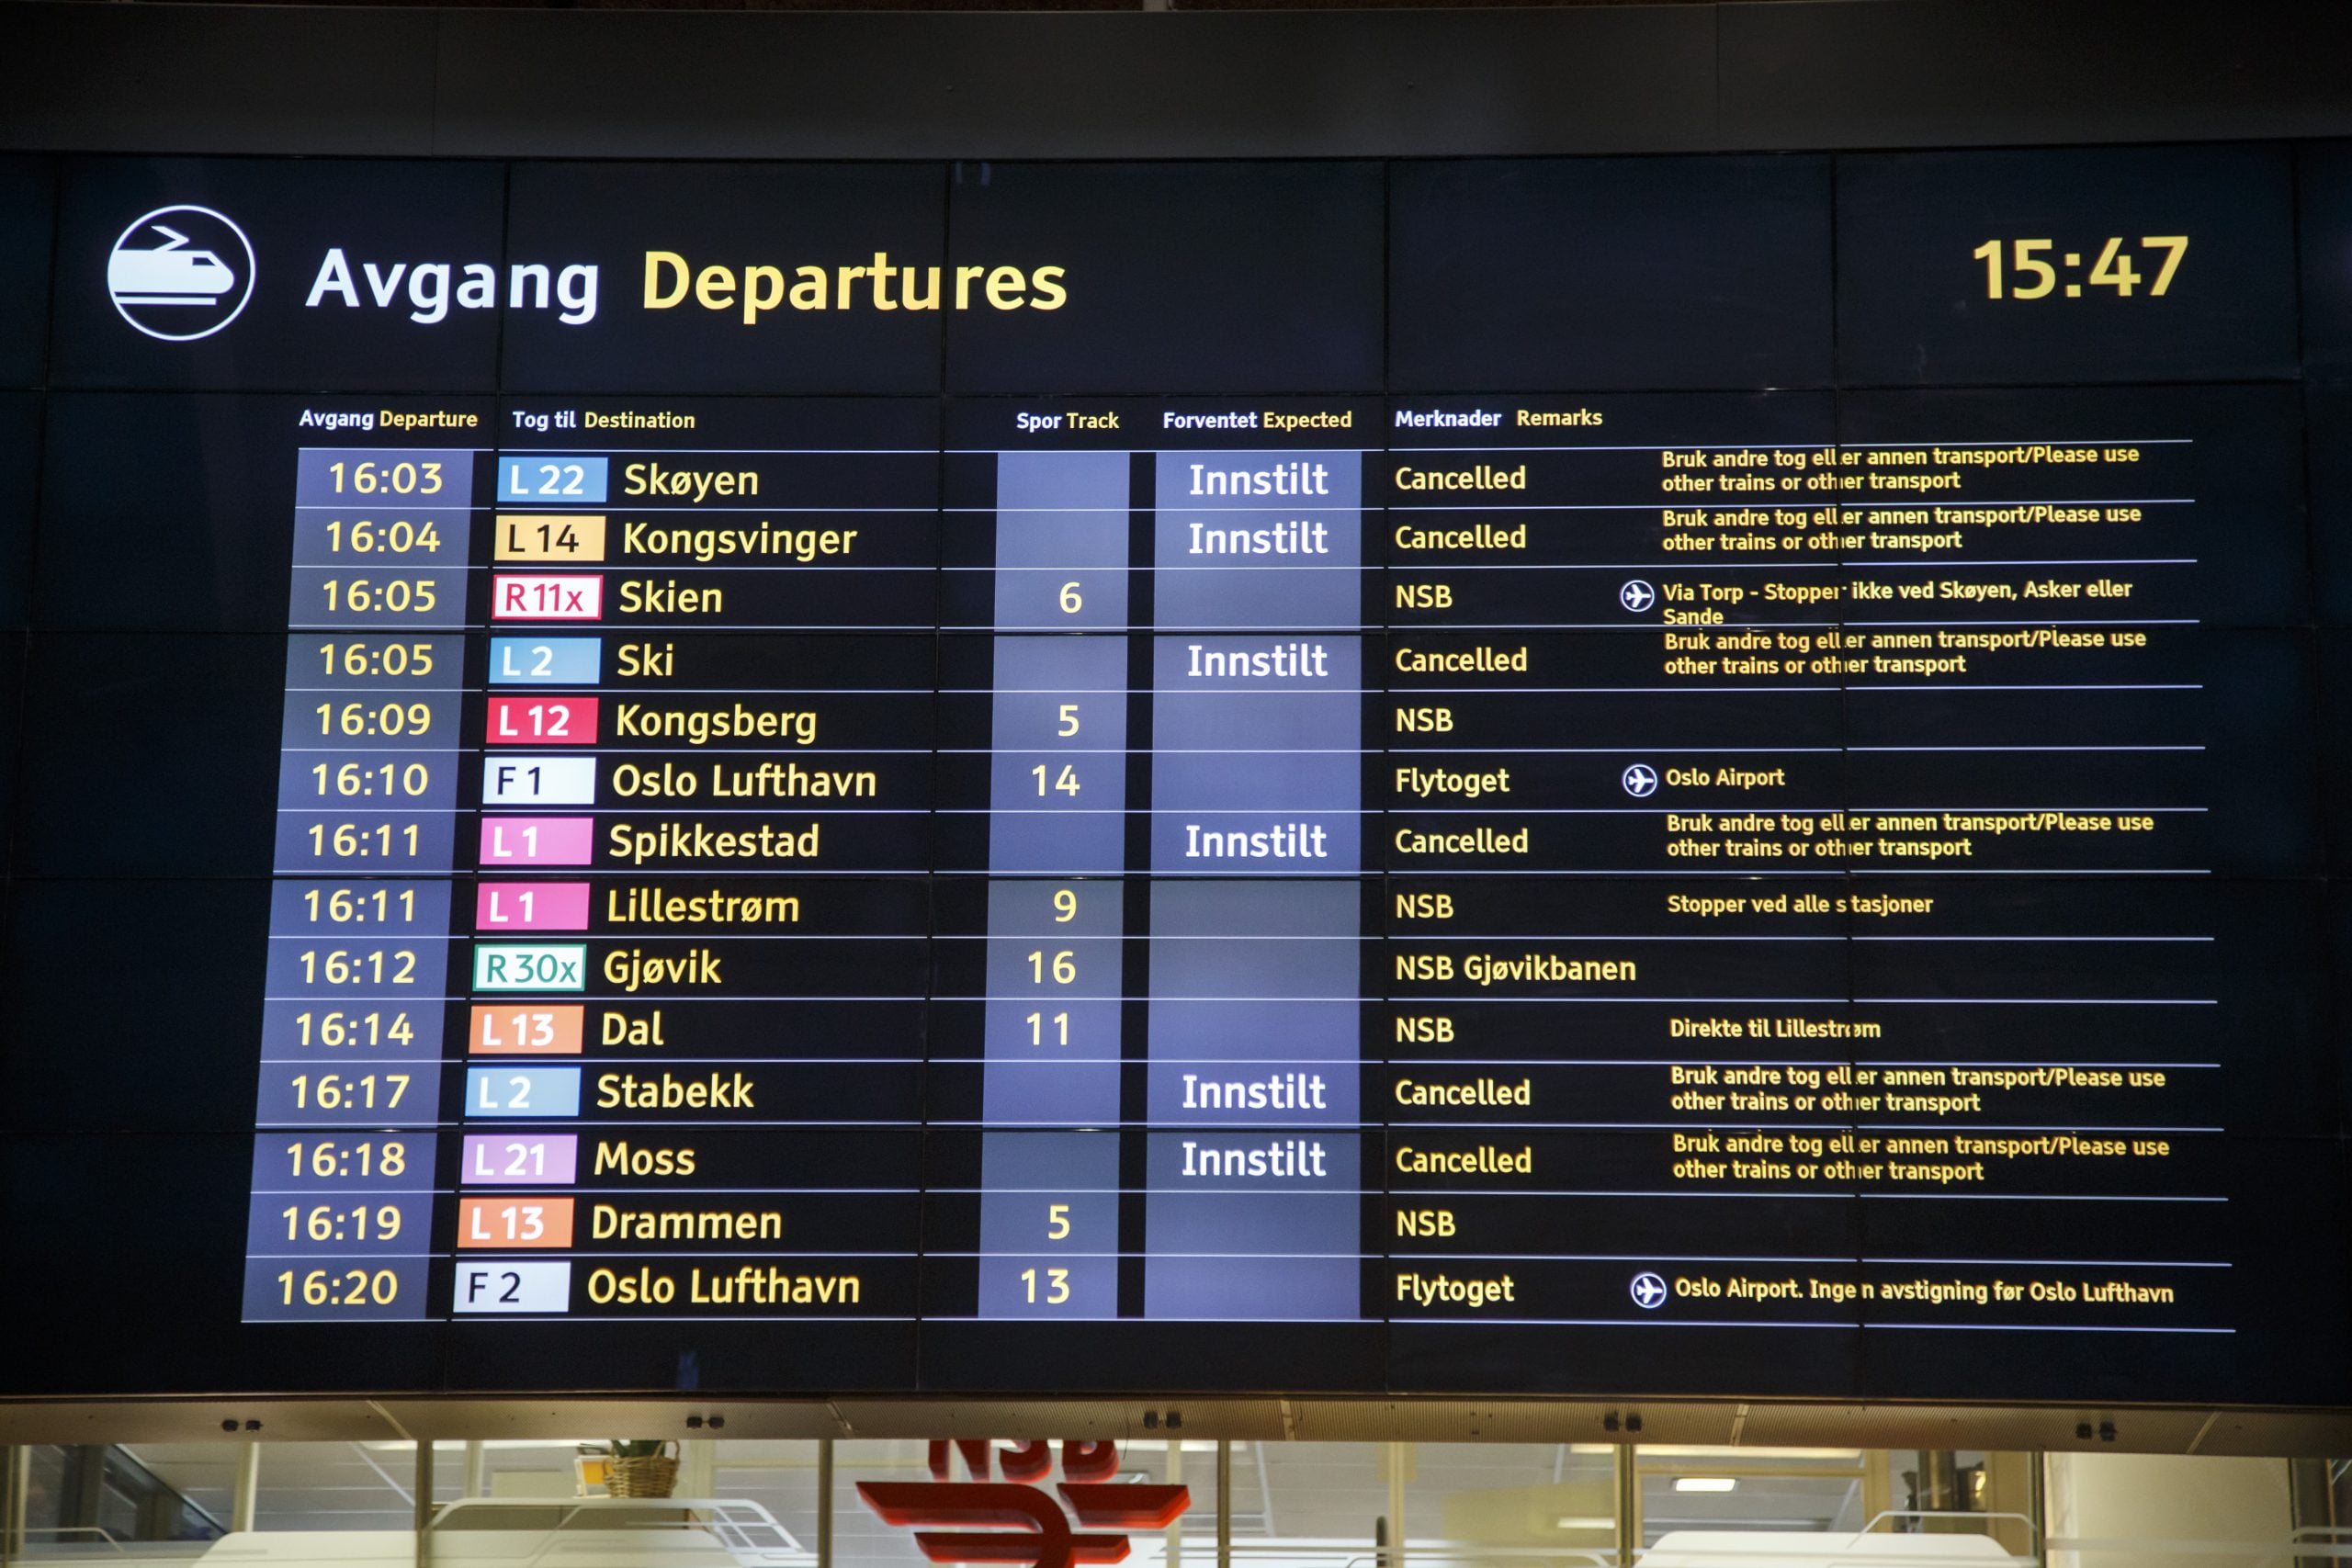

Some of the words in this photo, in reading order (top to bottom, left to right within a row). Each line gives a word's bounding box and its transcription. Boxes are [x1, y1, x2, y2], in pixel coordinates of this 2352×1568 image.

[1973, 235, 2188, 299] 15:47
[305, 248, 598, 325] Avgang
[643, 251, 1068, 325] Departures
[299, 410, 374, 431] Avgang
[379, 410, 479, 431] Departure
[512, 411, 548, 432] Tog
[554, 411, 577, 428] til
[584, 411, 695, 429] Destination
[1016, 412, 1062, 434] Spor
[1066, 411, 1119, 429] Track
[1163, 412, 1258, 429] Forventet
[1263, 411, 1352, 432] Expected
[1395, 409, 1502, 427] Merknader
[1517, 408, 1603, 426] Remarks
[1662, 449, 1708, 468] Bruk
[1712, 448, 1769, 468] andre
[1772, 449, 1806, 470] tog
[1811, 447, 1862, 467] eller
[1866, 451, 1928, 466] annen
[1931, 445, 2098, 468] transport/Please
[2103, 448, 2140, 463] use
[331, 462, 442, 494] 16:03
[625, 462, 758, 503] Skøyen
[1190, 462, 1329, 495] Innstilt
[1395, 465, 1526, 491] Cancelled
[1661, 473, 1714, 492] other
[1718, 472, 1776, 491] trains
[1780, 477, 1803, 491] or
[1806, 471, 1865, 491] other
[1868, 471, 1962, 493] transport
[327, 520, 441, 553] 16:04
[624, 521, 858, 562] Kongsvinger
[1189, 521, 1329, 554] Innstilt
[1395, 524, 1526, 549] Cancelled
[322, 580, 435, 613] 16:05
[619, 580, 722, 614] Skien
[1060, 582, 1081, 613] 6
[1396, 584, 1453, 609] NSB
[1662, 582, 1695, 602] Via
[1699, 583, 1744, 605] Torp
[1764, 582, 1847, 604] Stopper
[1851, 581, 1894, 600] ikke
[1897, 580, 1934, 600] ved
[1939, 580, 2018, 603] Skøyen,
[2022, 580, 2082, 599] Asker
[2086, 579, 2132, 598] eller
[1662, 606, 1724, 626] Sande
[320, 643, 433, 676] 16:05
[616, 643, 673, 677] Ski
[1188, 643, 1329, 677] Innstilt
[1396, 646, 1527, 672] Cancelled
[316, 703, 431, 736] 16:09
[616, 703, 817, 745] Kongsberg
[1059, 705, 1079, 737] 5
[1396, 707, 1453, 732] NSB
[314, 763, 429, 795] 16:10
[613, 762, 697, 797] Oslo
[713, 762, 876, 797] Lufthavn
[1034, 764, 1079, 795] 14
[1396, 767, 1510, 798] Flytoget
[1665, 767, 1711, 786] Oslo
[1715, 767, 1786, 791] Airport
[310, 824, 418, 856] 16:11
[609, 822, 820, 865] Spikkestad
[1185, 823, 1328, 858] Innstilt
[1395, 827, 1529, 853] Cancelled
[306, 888, 414, 921] 16:11
[607, 887, 799, 922] Lillestrøm
[1053, 889, 1077, 922] 9
[1396, 894, 1454, 919] NSB
[1668, 895, 1747, 918] Stopper
[1750, 894, 1787, 913] ved
[1792, 894, 1830, 913] alle
[301, 950, 415, 983] 16:12
[604, 949, 722, 993] Gjøvik
[1028, 950, 1076, 984] 16
[1396, 954, 1454, 981] NSB
[1464, 953, 1636, 986] Gjøvikbanen
[297, 1012, 413, 1046] 16:14
[602, 1010, 664, 1045] Dal
[1028, 1013, 1068, 1044] 11
[1396, 1017, 1454, 1043] NSB
[1669, 1017, 1743, 1038] Direkte
[1747, 1018, 1771, 1038] til
[1775, 1018, 1882, 1038] Lillestrøm
[293, 1074, 410, 1109] 16:17
[597, 1072, 754, 1109] Stabekk
[1182, 1073, 1327, 1109] Innstilt
[1395, 1077, 1531, 1106] Cancelled
[1670, 1065, 1718, 1085] Bruk
[1723, 1065, 1781, 1086] andre
[1785, 1066, 1821, 1089] tog
[1826, 1066, 1879, 1086] eller
[1882, 1070, 1946, 1086] annen
[1950, 1066, 2123, 1090] transport/Please
[2128, 1072, 2166, 1088] use
[1670, 1089, 1726, 1111] other
[1729, 1090, 1790, 1111] trains
[1793, 1095, 1816, 1111] or
[1820, 1091, 1882, 1111] other
[1884, 1092, 1981, 1116] transport
[288, 1142, 406, 1177] 16:18
[594, 1141, 695, 1176] Moss
[1182, 1141, 1327, 1177] Innstilt
[1396, 1145, 1532, 1174] Cancelled
[284, 1204, 401, 1241] 16:19
[592, 1204, 782, 1239] Drammen
[1048, 1204, 1070, 1239] 5
[1396, 1210, 1456, 1237] NSB
[278, 1269, 398, 1305] 16:20
[587, 1267, 675, 1304] Oslo
[691, 1266, 860, 1303] Lufthavn
[1022, 1269, 1069, 1303] 13
[1396, 1272, 1515, 1307] Flytoget
[1674, 1276, 1722, 1298] Oslo
[1725, 1277, 1804, 1302] Airport.
[1809, 1278, 1875, 1303] Ingen
[1880, 1279, 1988, 1305] avstigning
[1992, 1280, 2025, 1302] før
[2029, 1280, 2077, 1302] Oslo
[2082, 1281, 2175, 1303] Lufthavn
